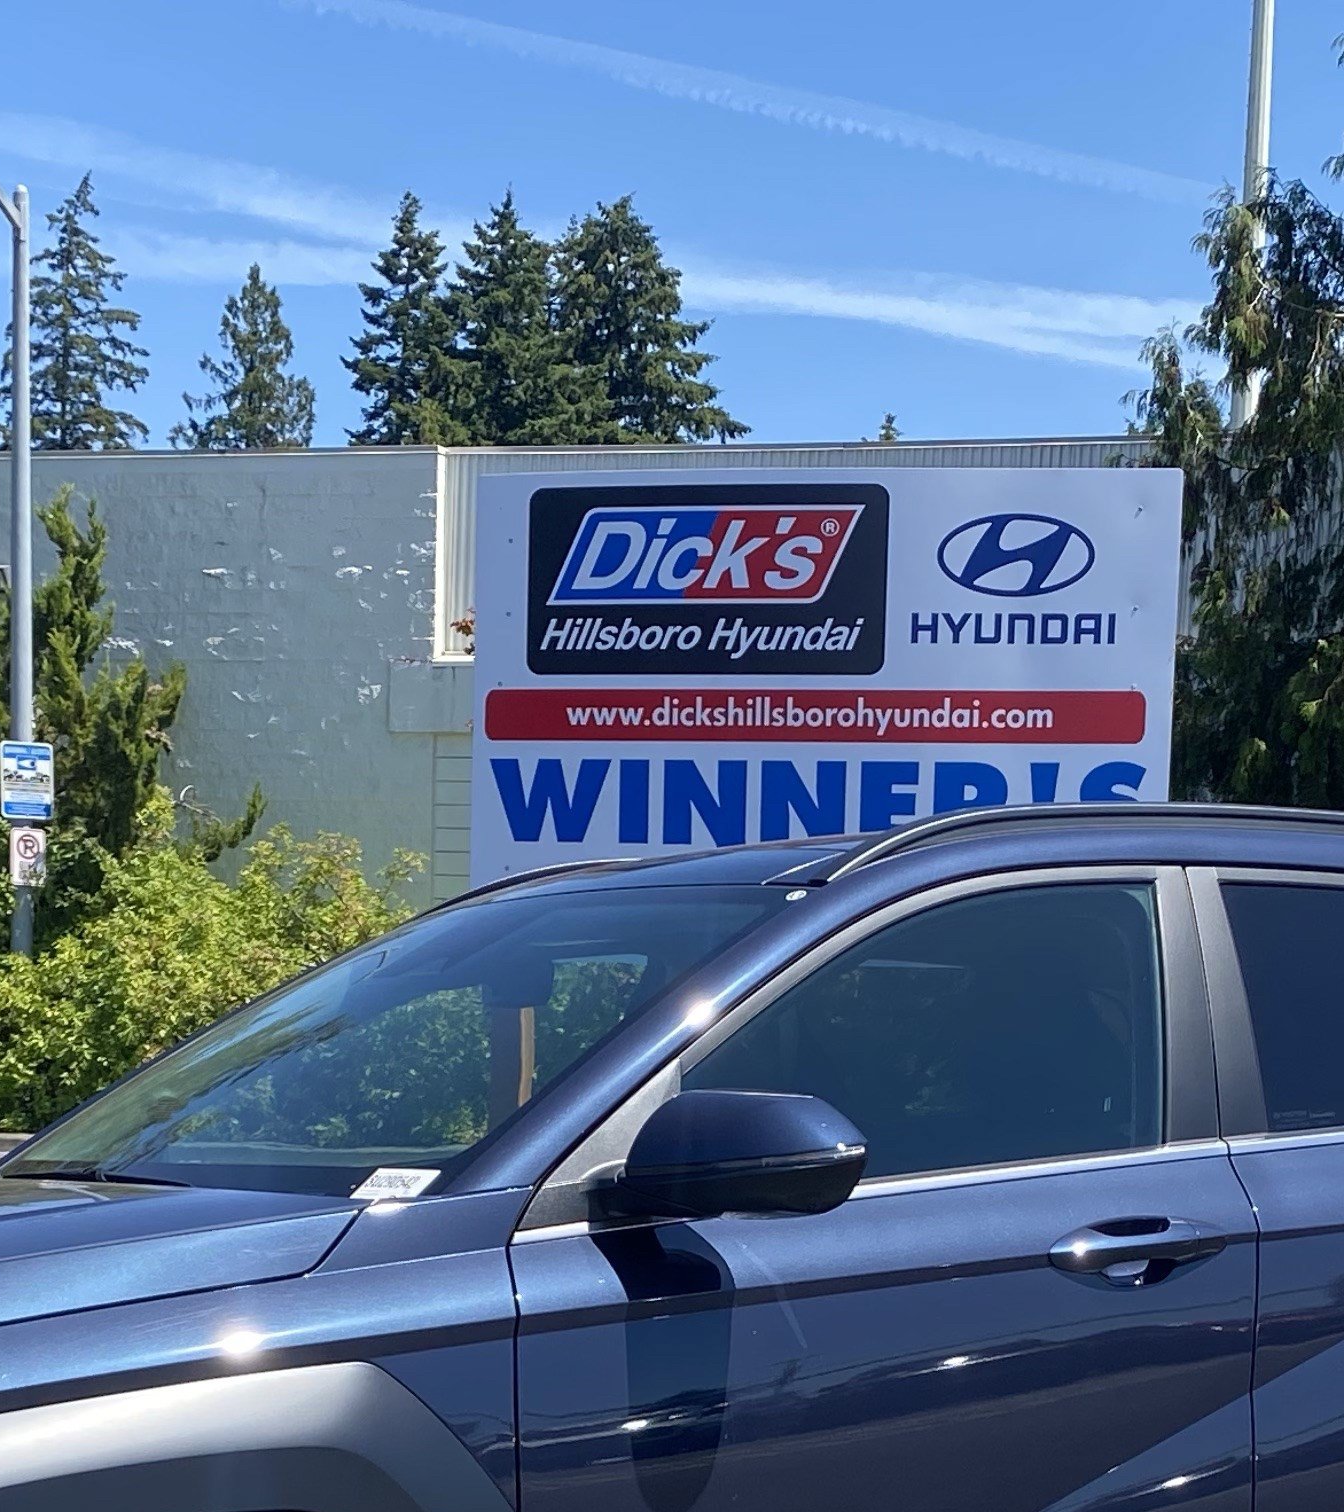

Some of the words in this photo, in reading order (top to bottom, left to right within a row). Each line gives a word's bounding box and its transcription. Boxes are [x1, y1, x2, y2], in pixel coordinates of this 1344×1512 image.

[539, 617, 703, 653] Hillsboro
[706, 617, 864, 659] Hyundai
[910, 611, 1117, 646] HYUNDAI
[565, 696, 1054, 738] www.dickshillsborohyundai.com
